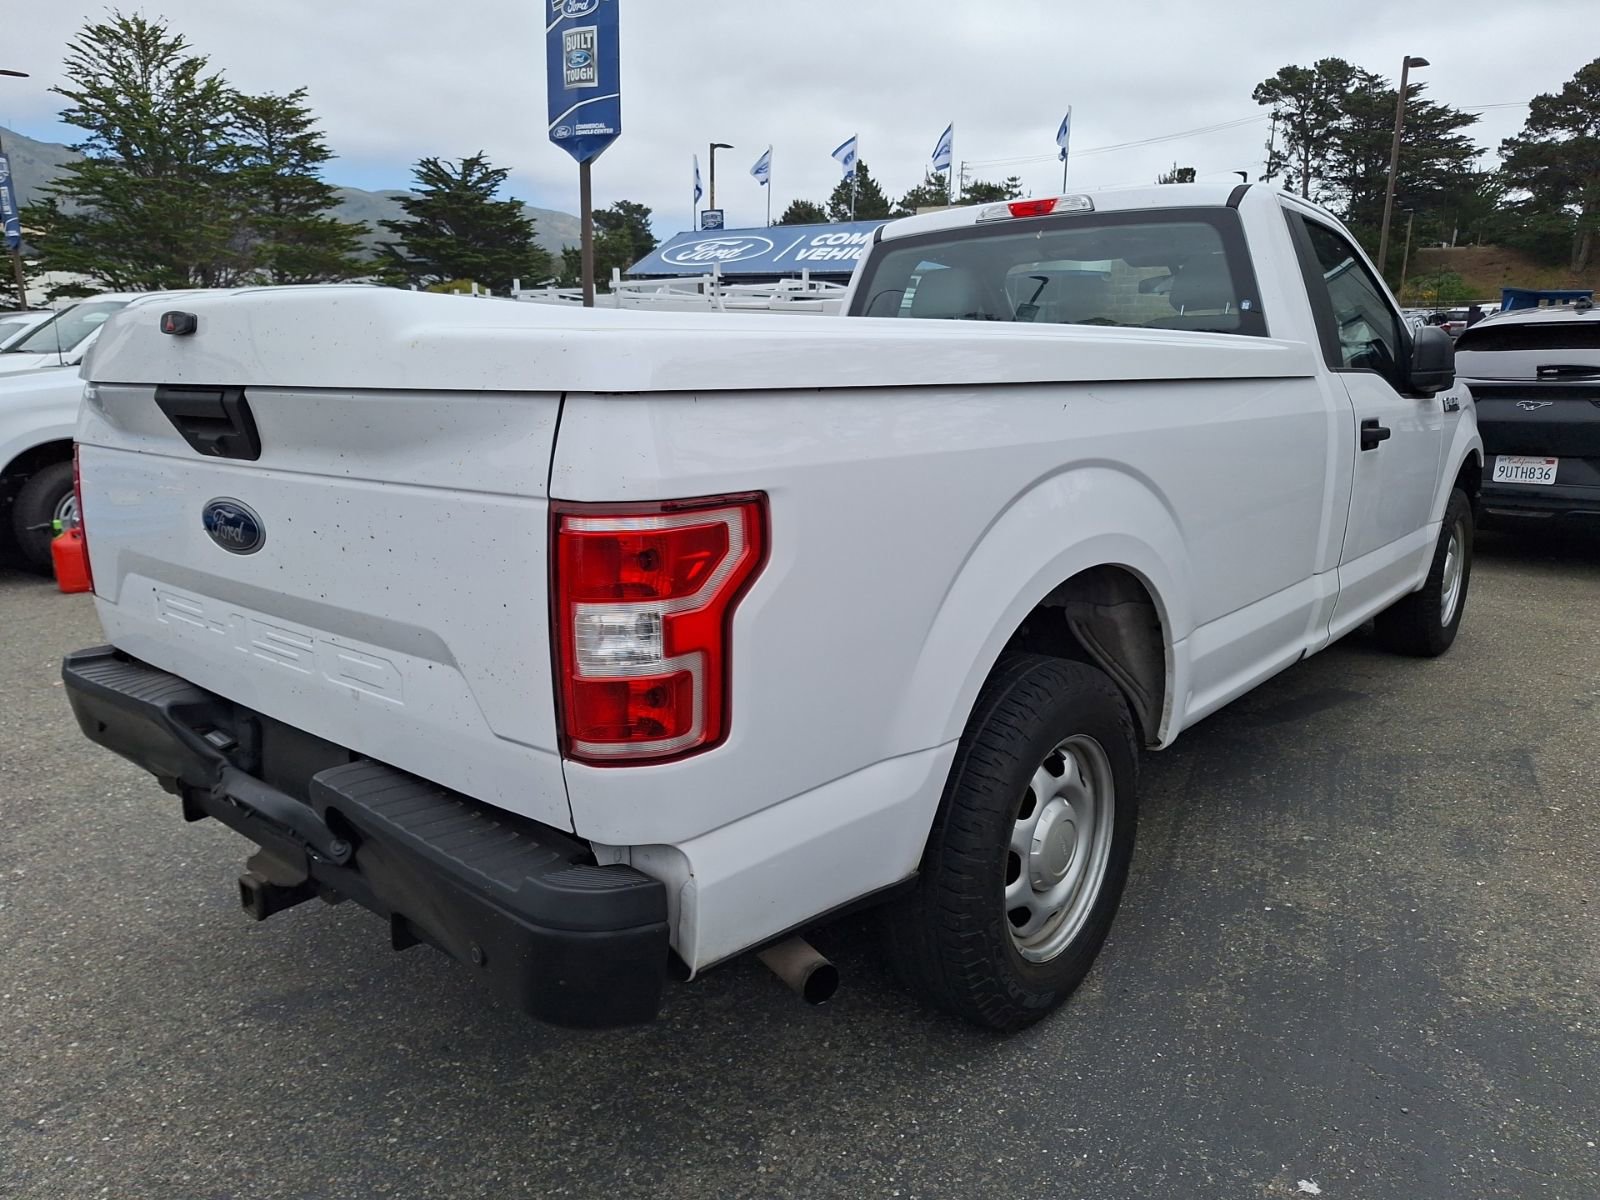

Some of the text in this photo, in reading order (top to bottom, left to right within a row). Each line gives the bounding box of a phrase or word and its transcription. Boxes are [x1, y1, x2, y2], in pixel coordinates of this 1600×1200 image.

[566, 34, 593, 51] BUILT
[566, 67, 593, 82] TOUGH
[675, 241, 754, 260] Ford
[1497, 465, 1553, 480] 9UTH836
[212, 508, 245, 543] Ford
[156, 590, 405, 706] F-150
